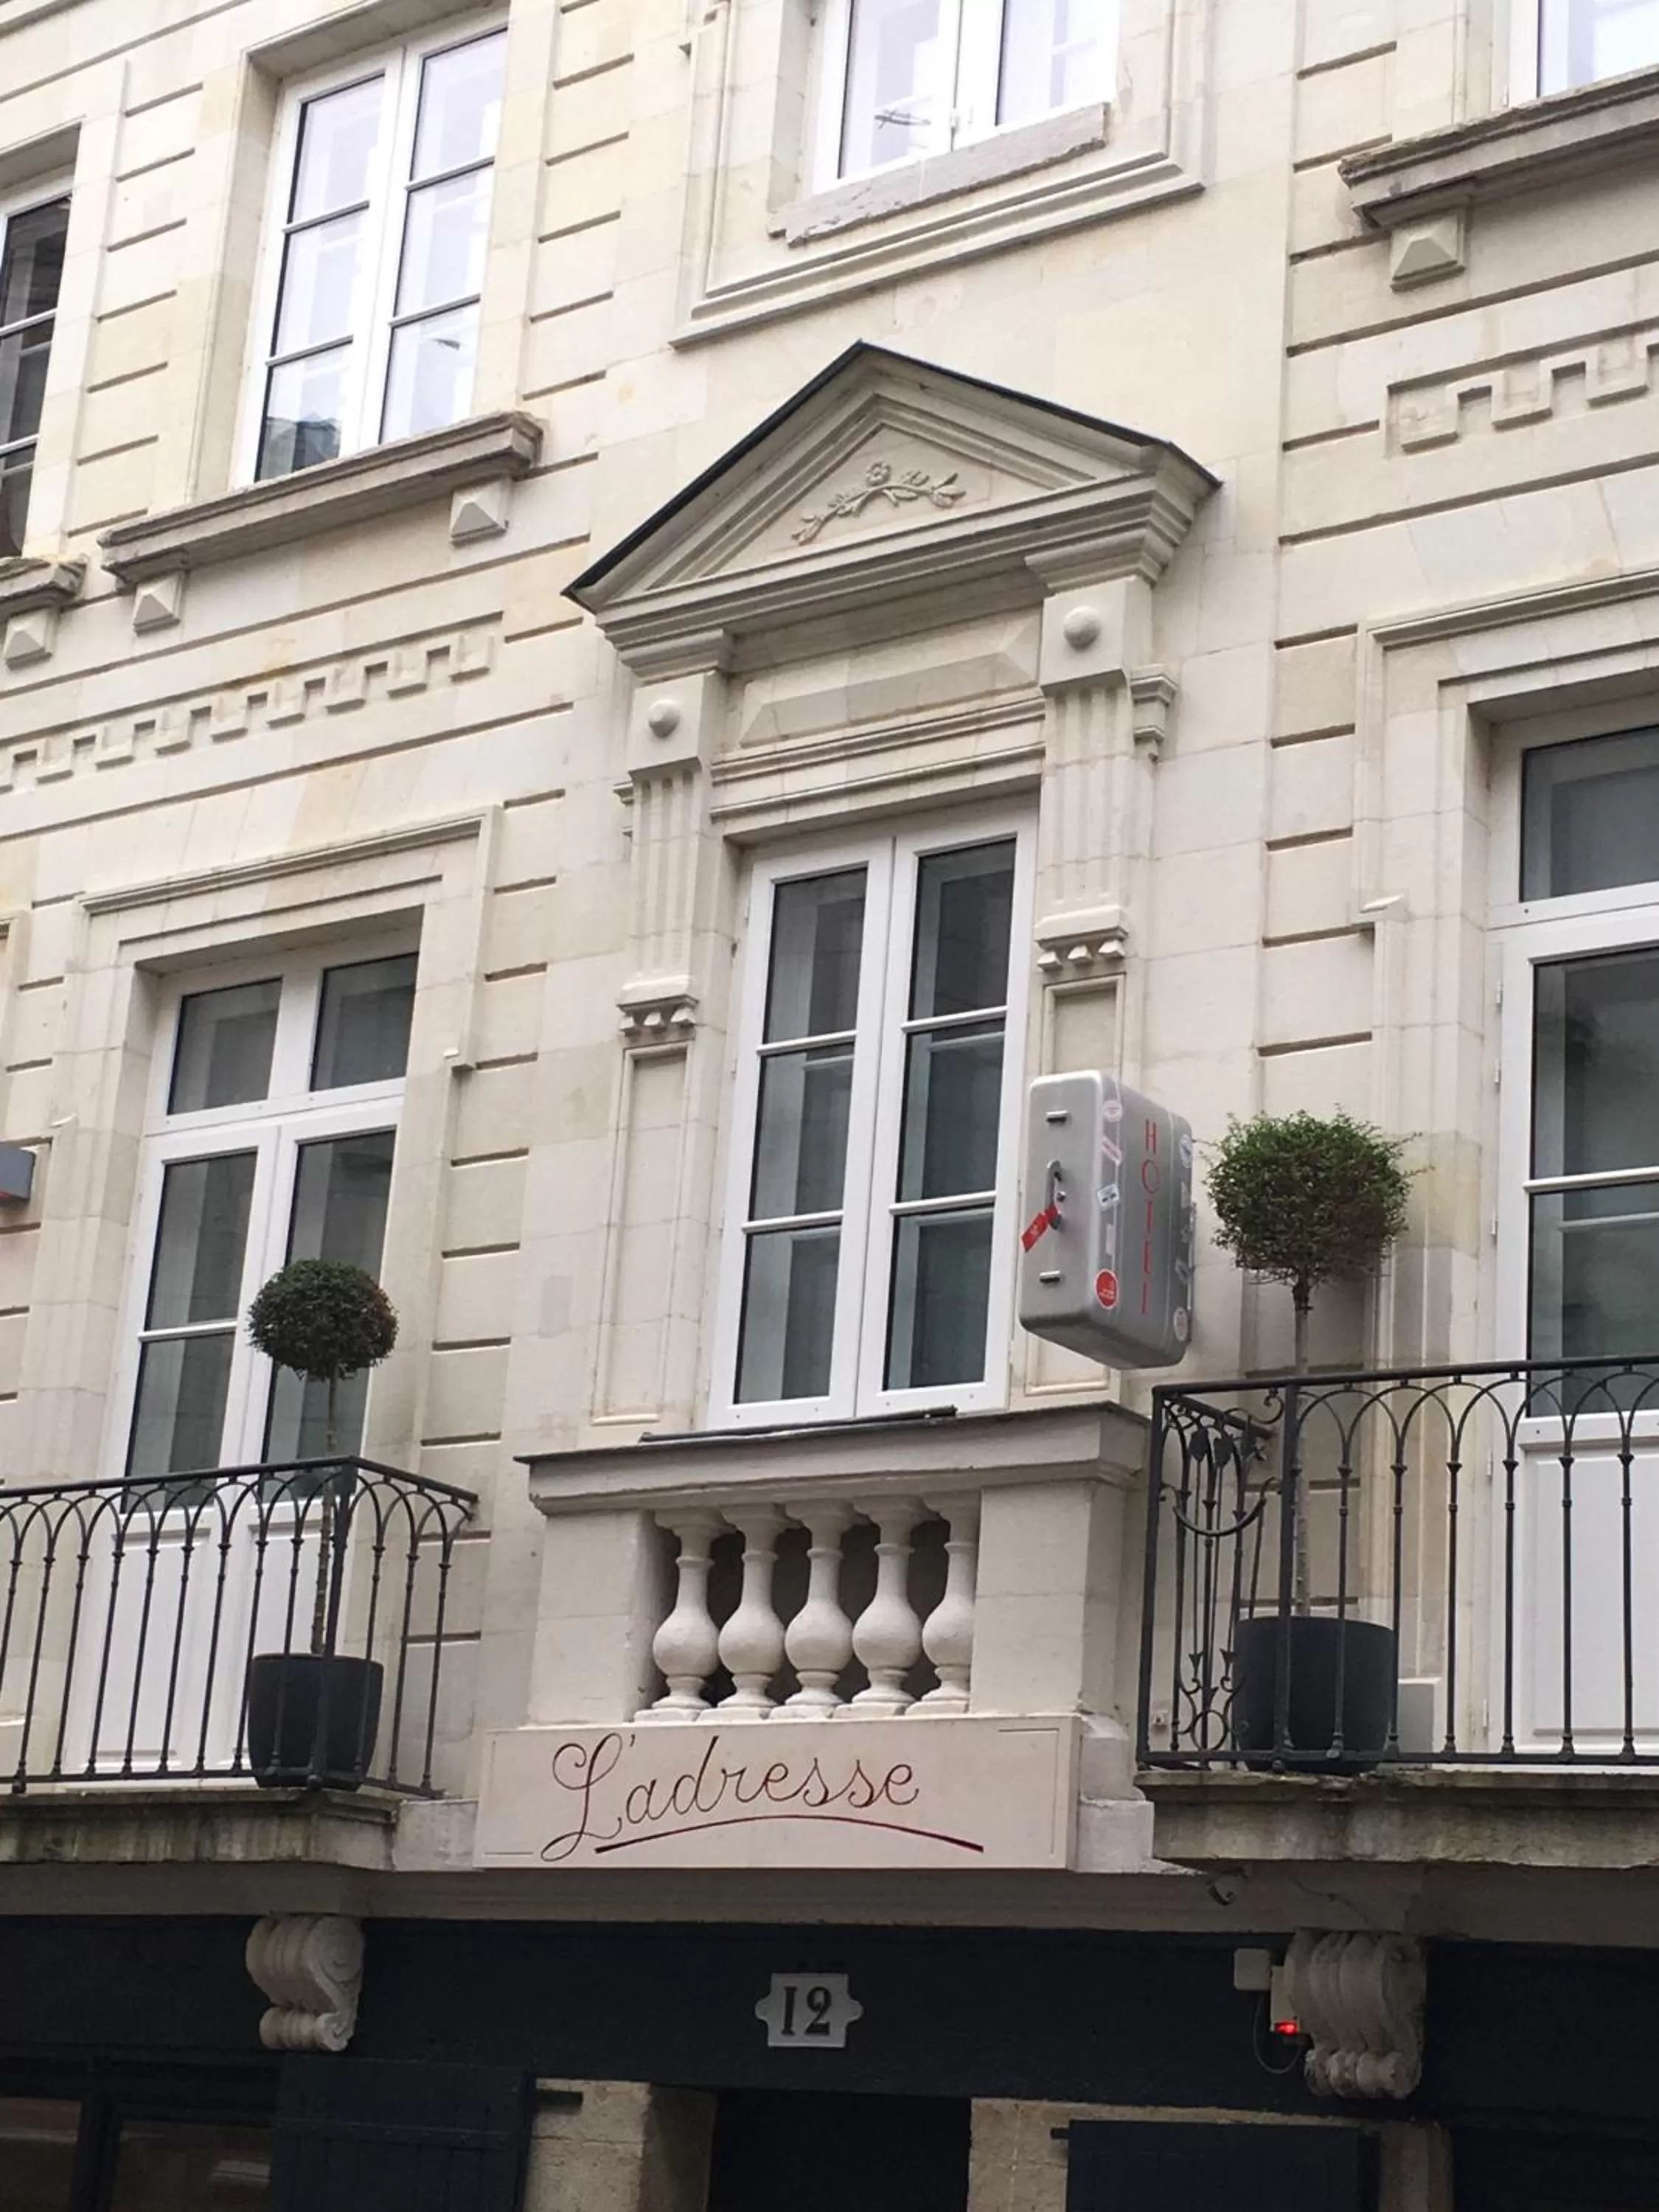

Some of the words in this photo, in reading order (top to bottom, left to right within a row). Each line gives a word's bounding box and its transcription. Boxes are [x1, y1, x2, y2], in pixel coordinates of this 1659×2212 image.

[1141, 1118, 1161, 1315] HOTEL
[540, 1733, 920, 1862] L'adresse
[781, 1986, 832, 2036] 12
